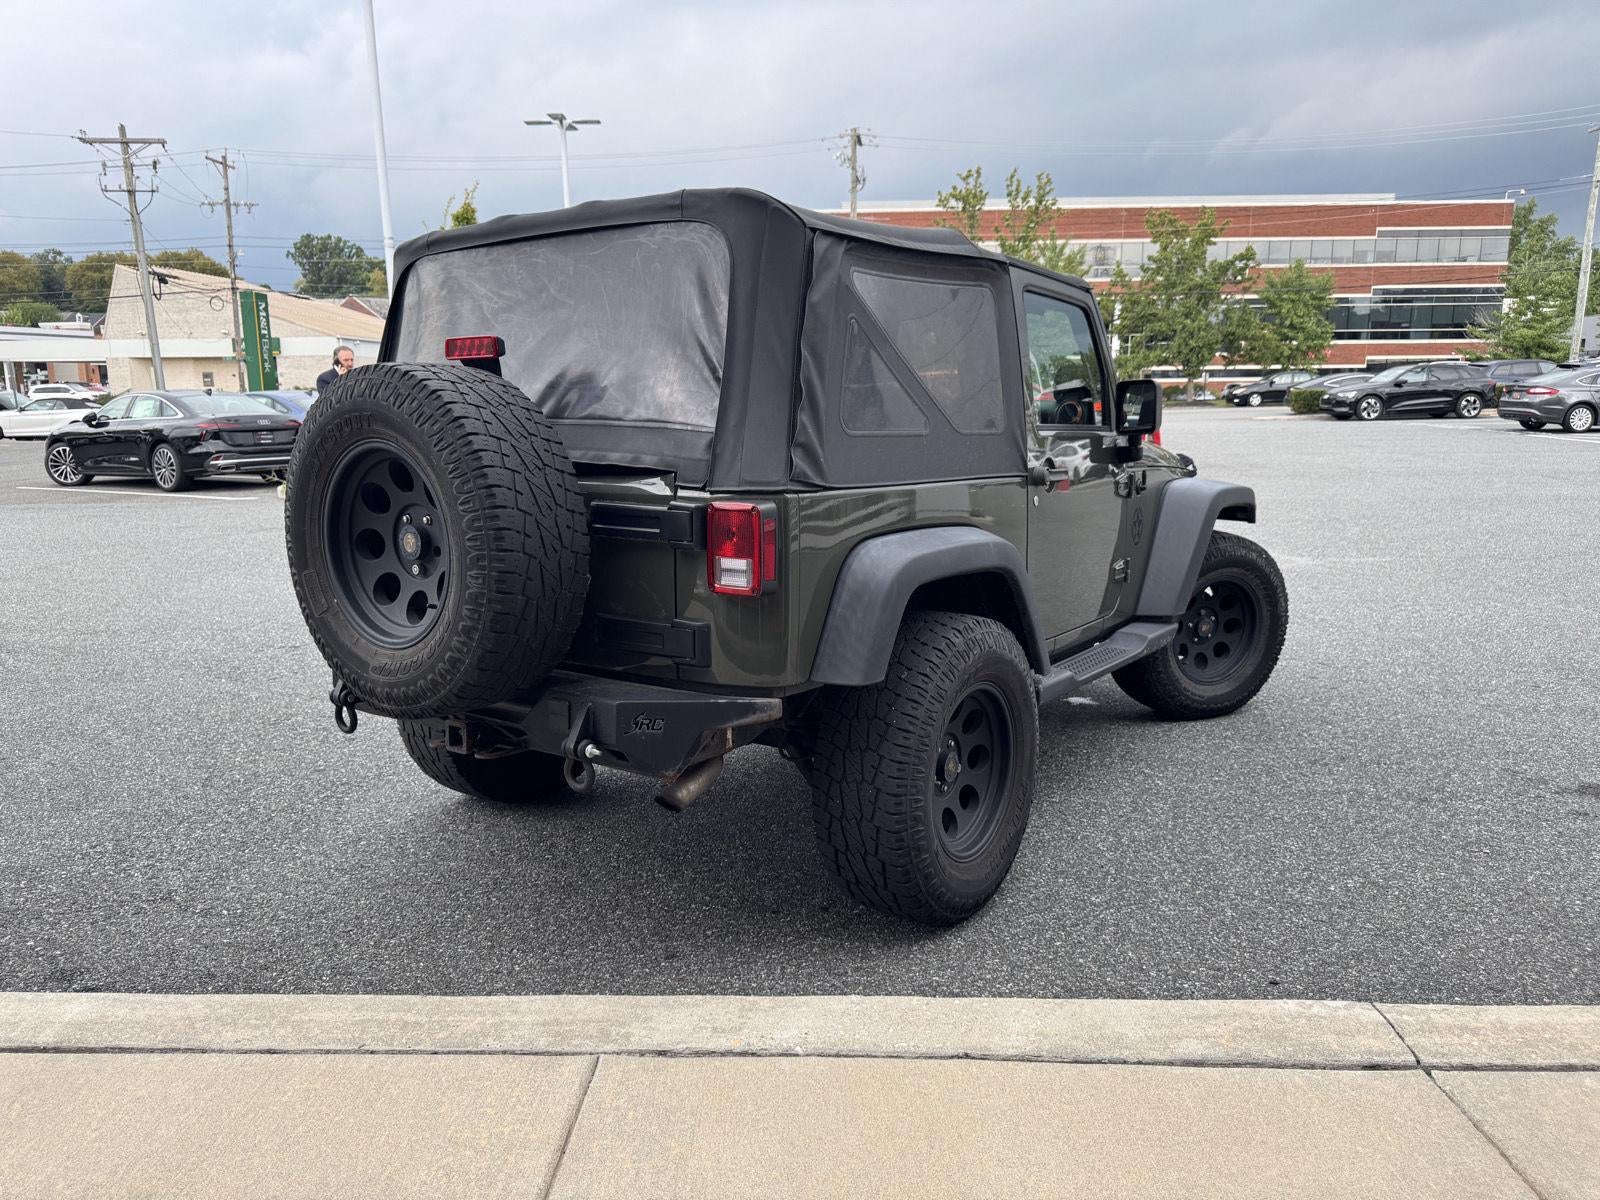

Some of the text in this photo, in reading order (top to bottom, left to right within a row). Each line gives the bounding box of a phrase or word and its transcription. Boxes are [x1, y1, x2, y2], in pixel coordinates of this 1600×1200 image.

[258, 302, 271, 373] M&T Bank
[326, 412, 373, 442] SPORT
[370, 653, 424, 678] COMP
